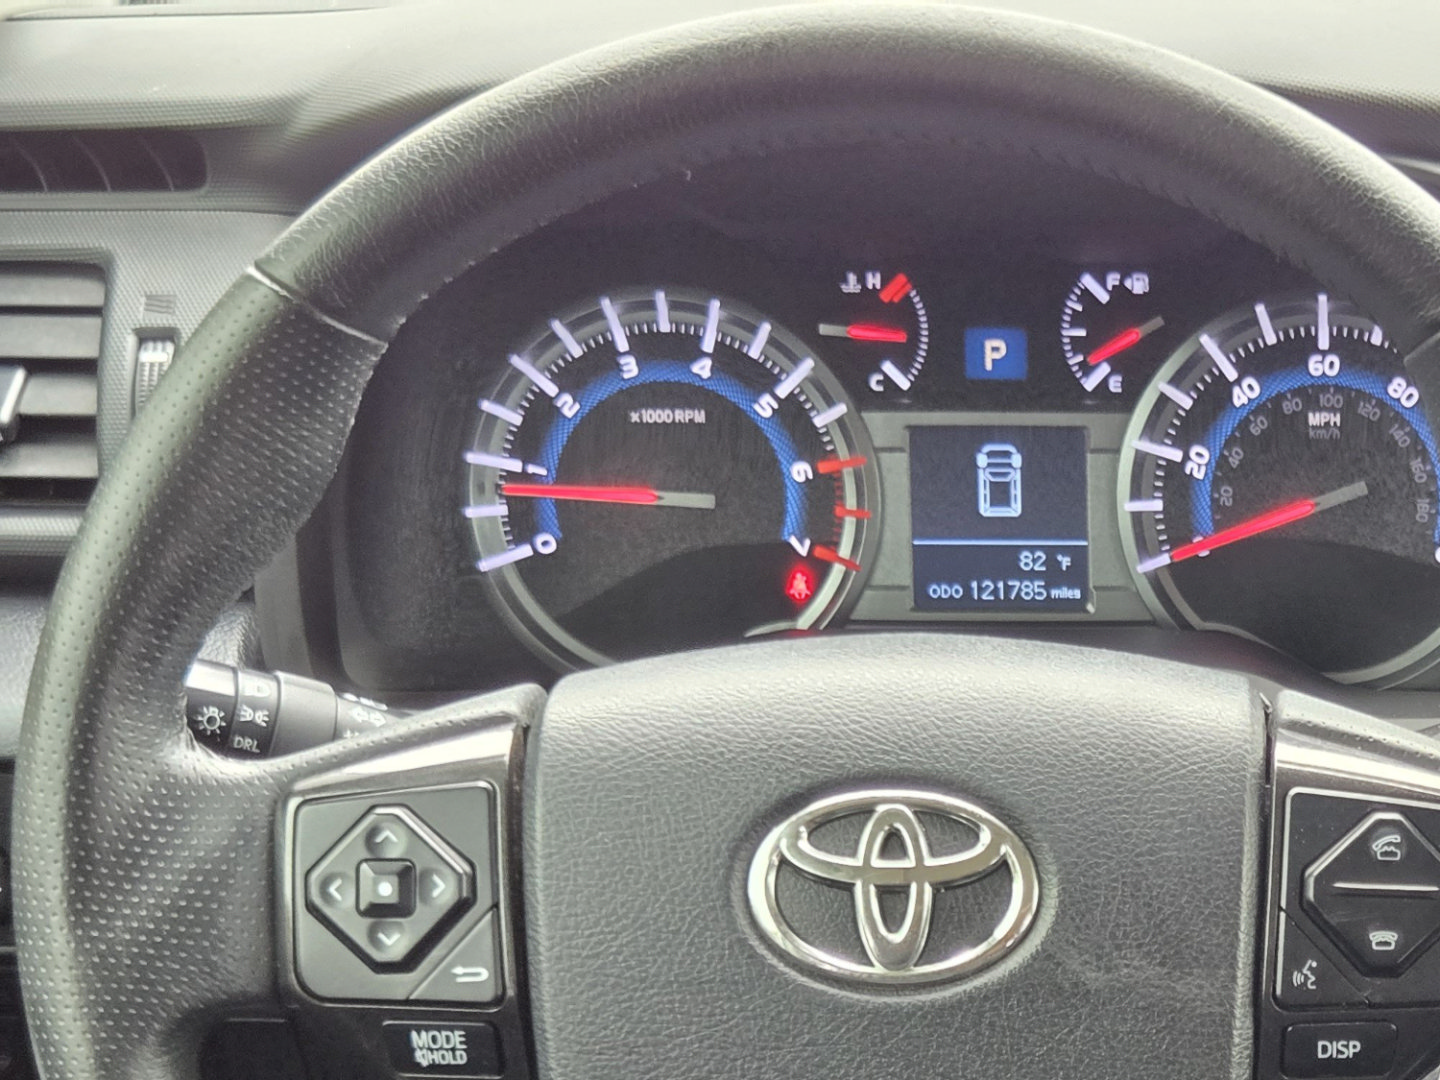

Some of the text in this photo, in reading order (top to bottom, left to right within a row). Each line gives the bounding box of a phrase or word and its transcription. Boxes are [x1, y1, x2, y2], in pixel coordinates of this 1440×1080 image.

[865, 272, 882, 289] H
[1106, 272, 1121, 290] F
[984, 338, 1007, 371] P
[1307, 354, 1340, 377] 60
[618, 355, 640, 378] 3
[689, 356, 713, 379] 4
[868, 375, 884, 392] C
[1108, 375, 1123, 393] E
[1231, 376, 1261, 408] 40
[1386, 376, 1420, 409] 80
[556, 392, 581, 419] 2
[752, 396, 779, 419] 5
[1282, 397, 1303, 415] 80
[1318, 393, 1344, 409] 100
[1356, 397, 1381, 422] 120
[1248, 415, 1269, 437] 60
[1308, 411, 1341, 427] MPH
[1308, 426, 1341, 441] km/h
[1185, 445, 1211, 480] 20
[1228, 446, 1245, 470] 40
[526, 462, 549, 477] 1
[789, 460, 813, 483] 6
[1219, 485, 1234, 507] 20
[532, 533, 558, 555] 0
[788, 534, 812, 557] 7
[1018, 551, 1047, 571] 82
[929, 580, 1082, 601] ODO 121785 miles
[233, 734, 261, 753] DRL
[411, 1029, 468, 1050] MODE
[1317, 1040, 1361, 1059] DISP
[429, 1050, 468, 1065] HOLD
